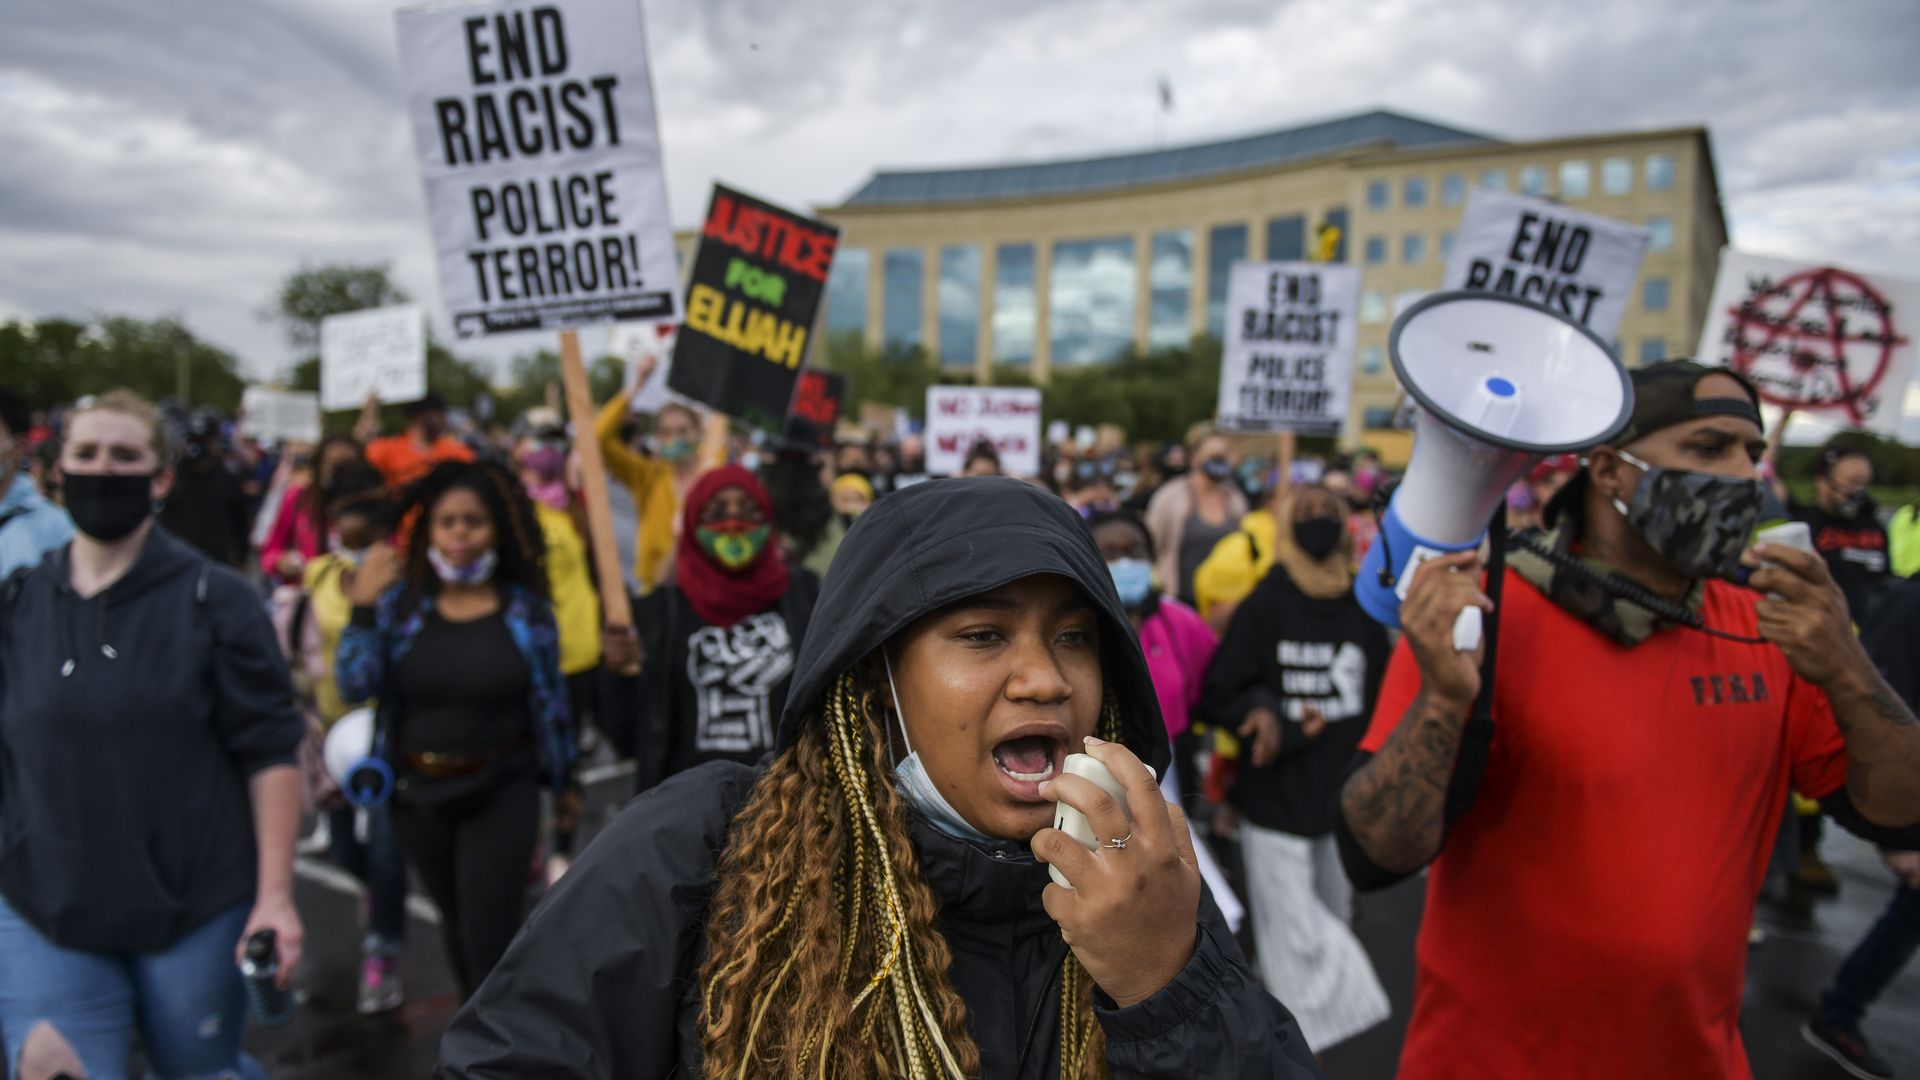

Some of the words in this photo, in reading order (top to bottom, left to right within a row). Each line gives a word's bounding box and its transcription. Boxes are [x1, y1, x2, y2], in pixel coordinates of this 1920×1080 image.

[464, 7, 569, 86] END
[435, 76, 620, 165] RACIST
[470, 172, 619, 241] POLICE
[704, 194, 838, 283] JUSTICE
[468, 235, 644, 303] TERROR!
[1509, 210, 1592, 275] END
[725, 258, 787, 309] FOR
[1268, 271, 1321, 306] END
[686, 283, 807, 370] ELIJAH
[1242, 309, 1340, 344] RACIST
[1248, 354, 1325, 381] POLICE
